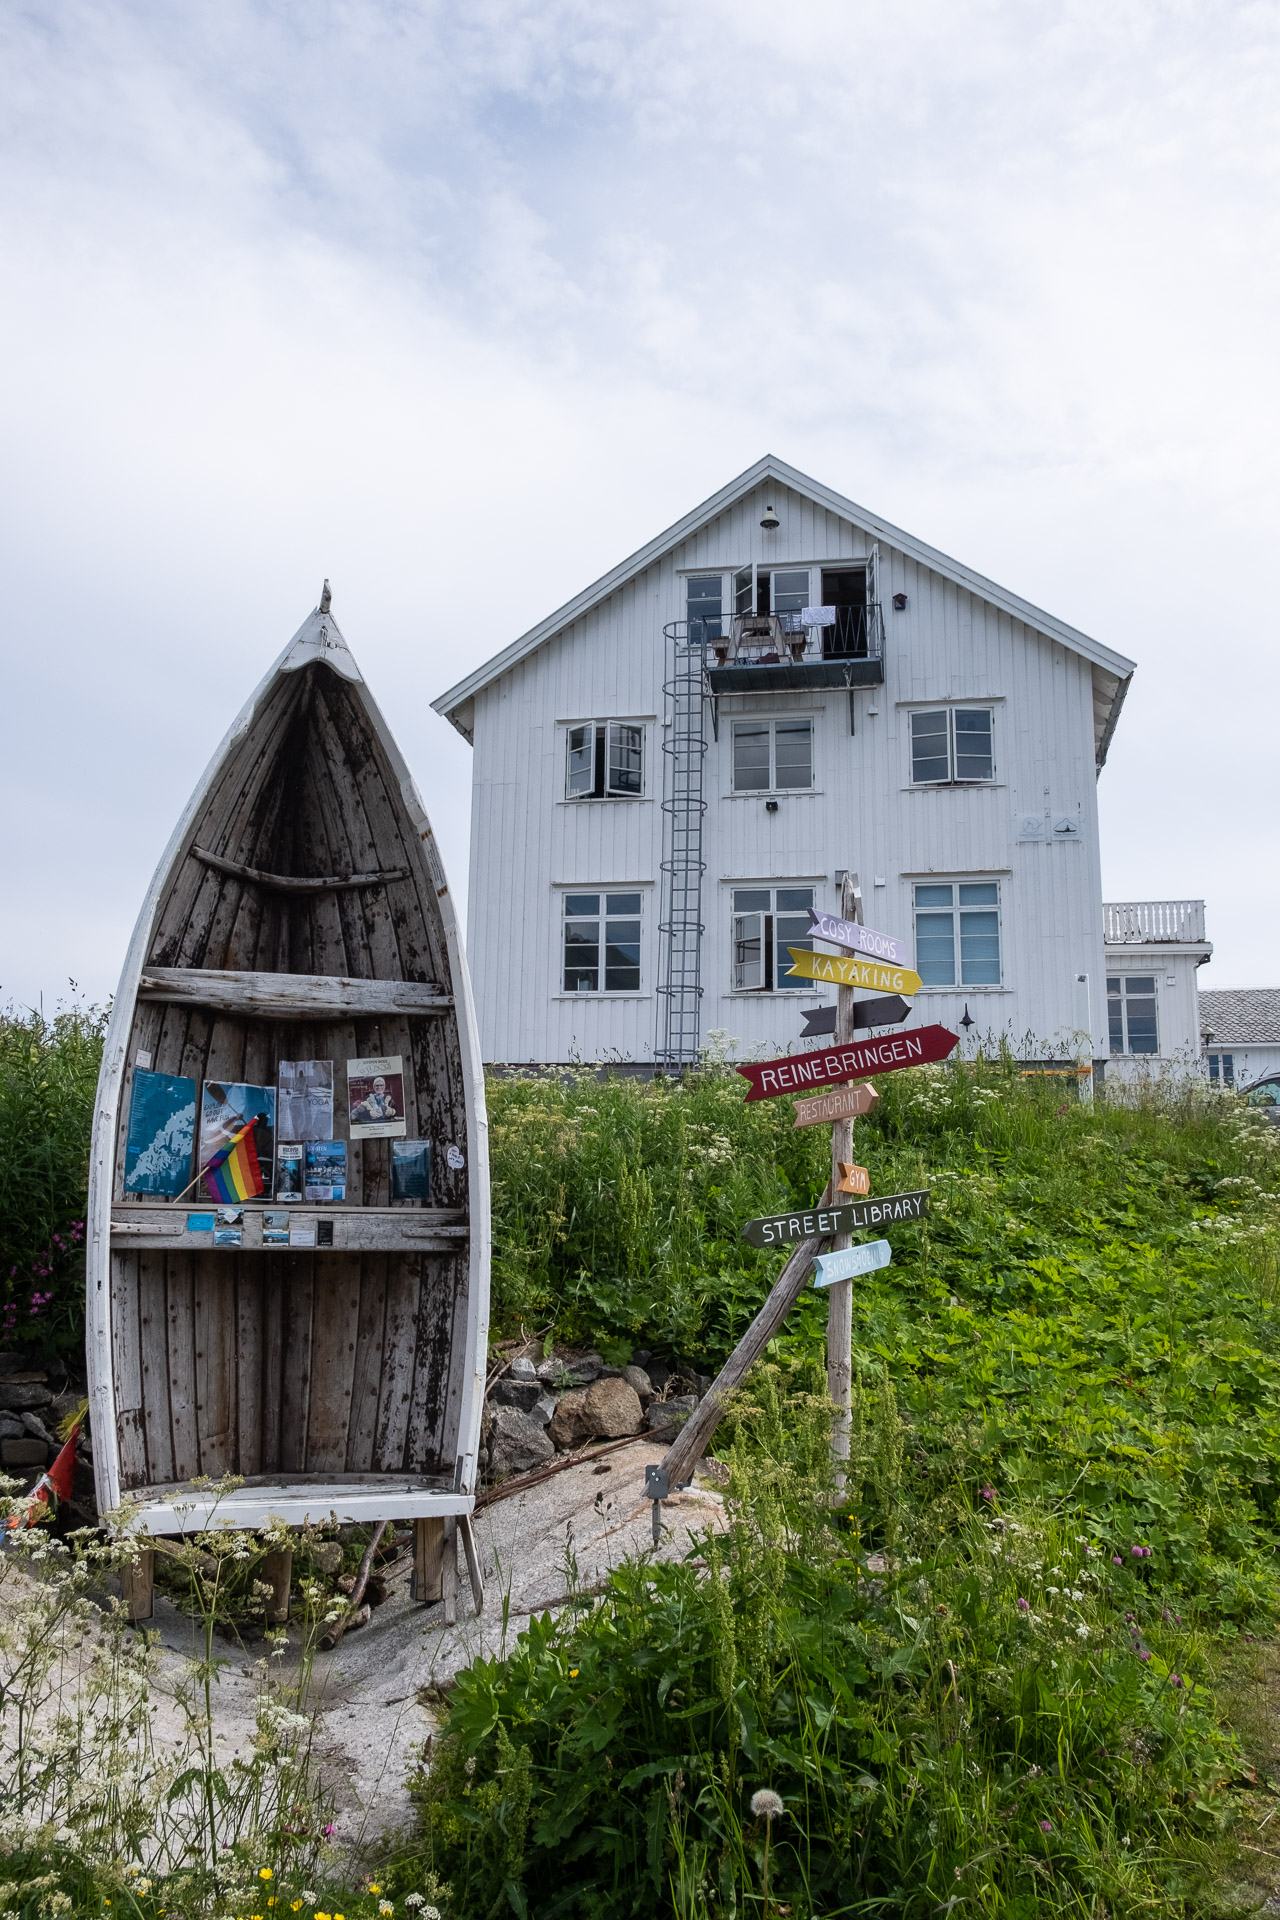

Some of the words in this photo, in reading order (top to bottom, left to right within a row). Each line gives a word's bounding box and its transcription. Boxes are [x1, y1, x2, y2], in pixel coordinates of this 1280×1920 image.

[820, 917, 853, 943] COSY
[859, 929, 897, 959] ROOMS
[812, 956, 904, 990] KAYAKING
[760, 1037, 923, 1092] REINEBRINGEN
[307, 1098, 330, 1106] YOGA
[800, 1090, 862, 1122] RESTAURANT
[849, 1169, 867, 1191] GYM
[762, 1211, 842, 1243] STREET
[852, 1196, 923, 1226] LIBRARY
[826, 1247, 885, 1279] SNOWSHOEING
